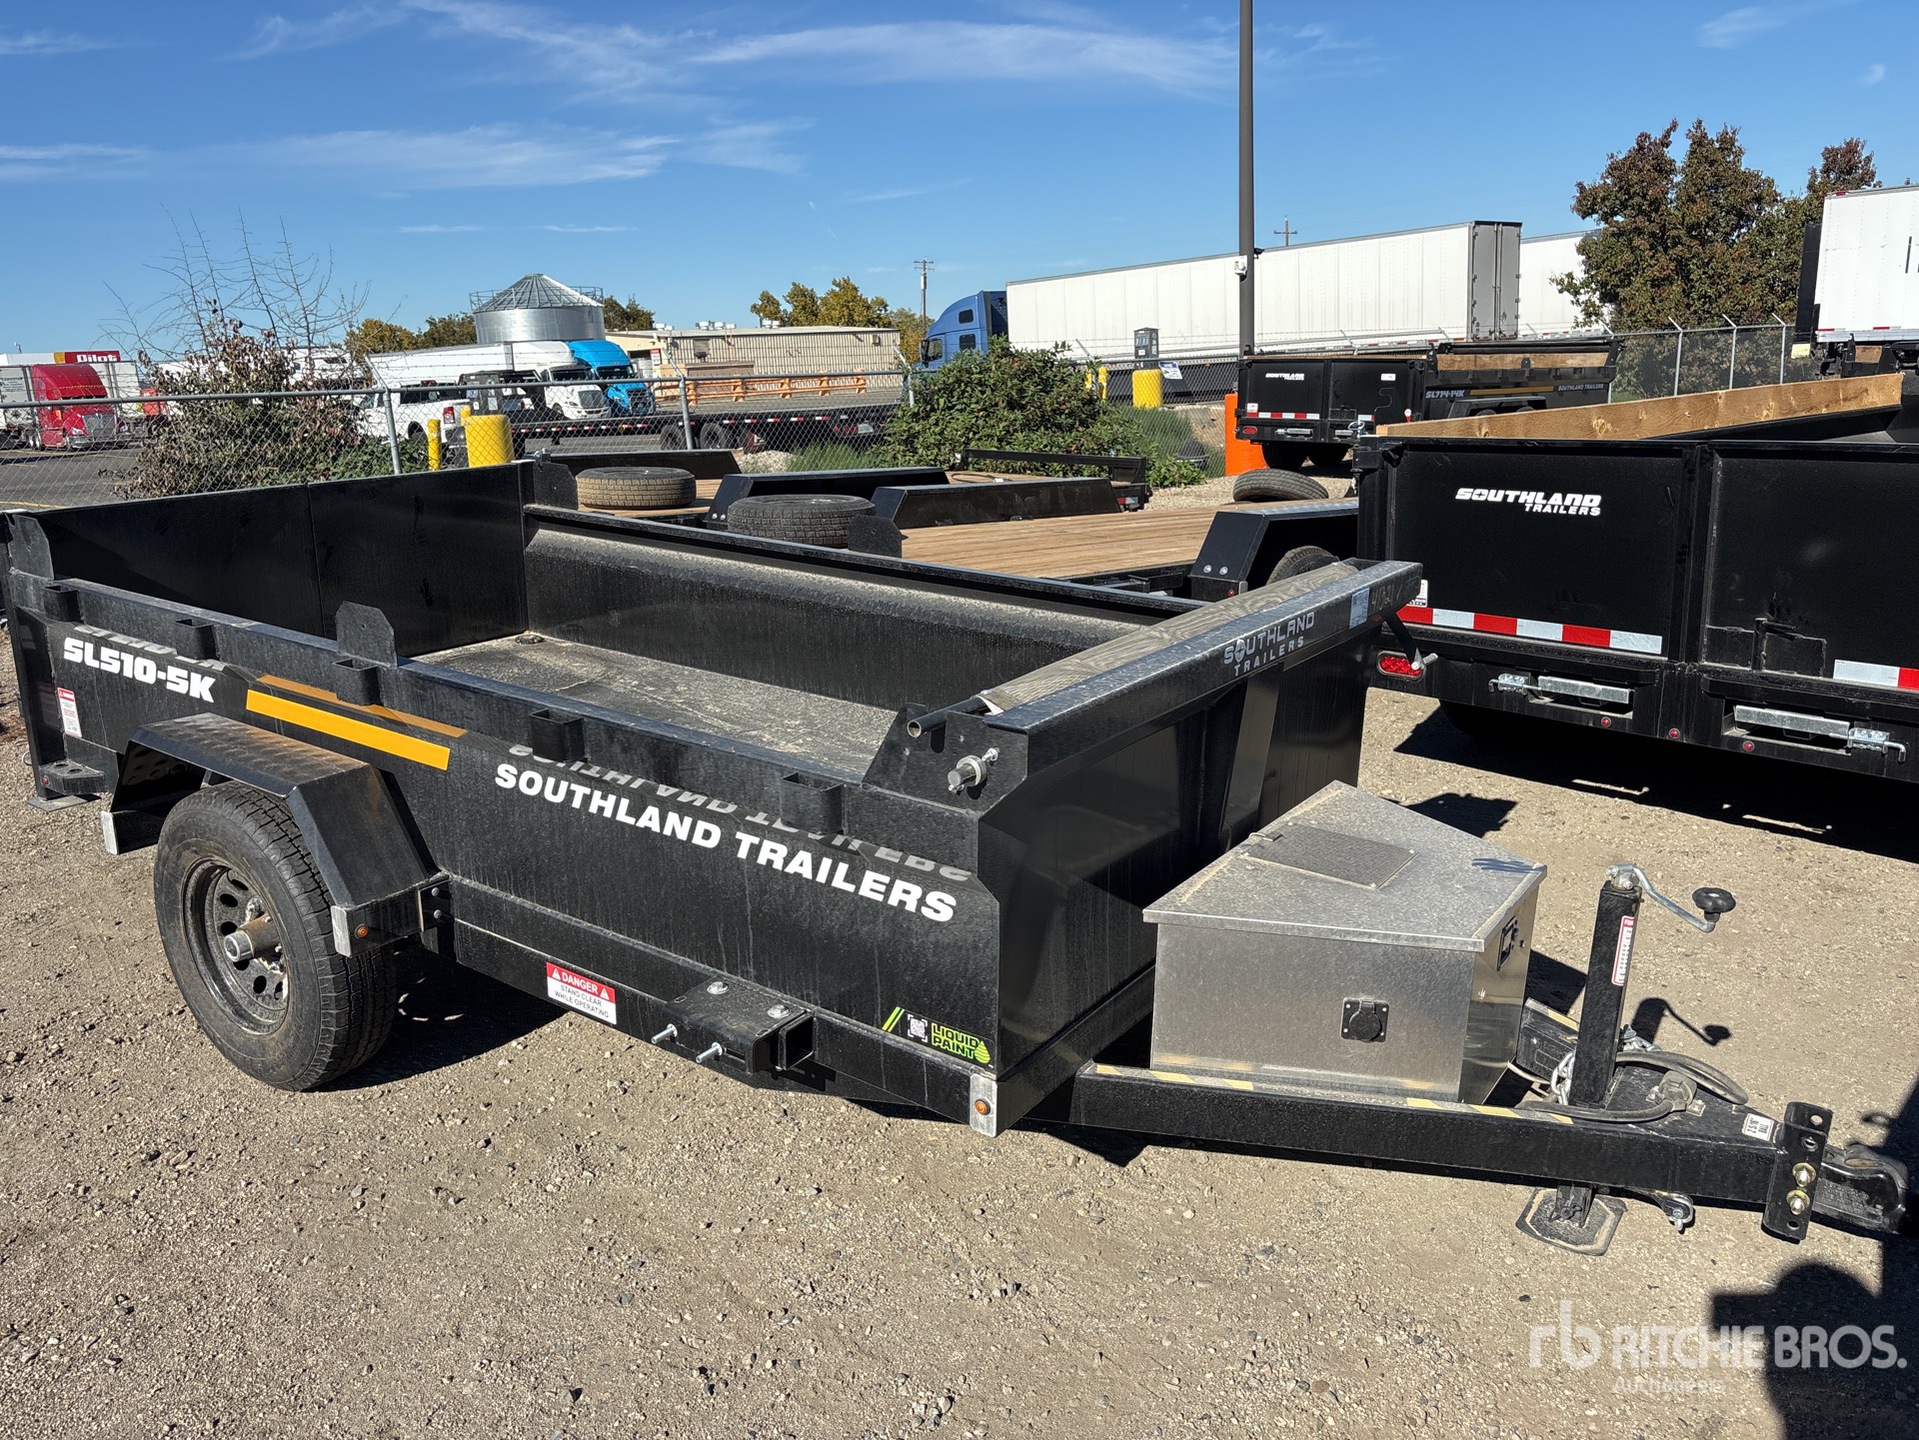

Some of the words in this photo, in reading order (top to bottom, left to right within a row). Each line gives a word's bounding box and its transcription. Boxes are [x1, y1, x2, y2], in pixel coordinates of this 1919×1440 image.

[77, 354, 117, 363] Pilot
[1455, 487, 1602, 507] SOUTHLAND
[1525, 503, 1601, 516] TRAILERS
[1224, 611, 1315, 663] SOUTHLAND
[1234, 637, 1304, 677] TRAILERS
[495, 763, 721, 849] SOUTHLAND
[735, 831, 957, 922] TRAILERS
[560, 984, 581, 997] STAND
[581, 993, 602, 1007] CLEAR
[561, 971, 599, 995] DANGER
[554, 989, 574, 1003] WHILE
[574, 999, 609, 1018] OPERATING
[931, 1022, 980, 1049] LIQUID
[931, 1034, 975, 1059] PAINT
